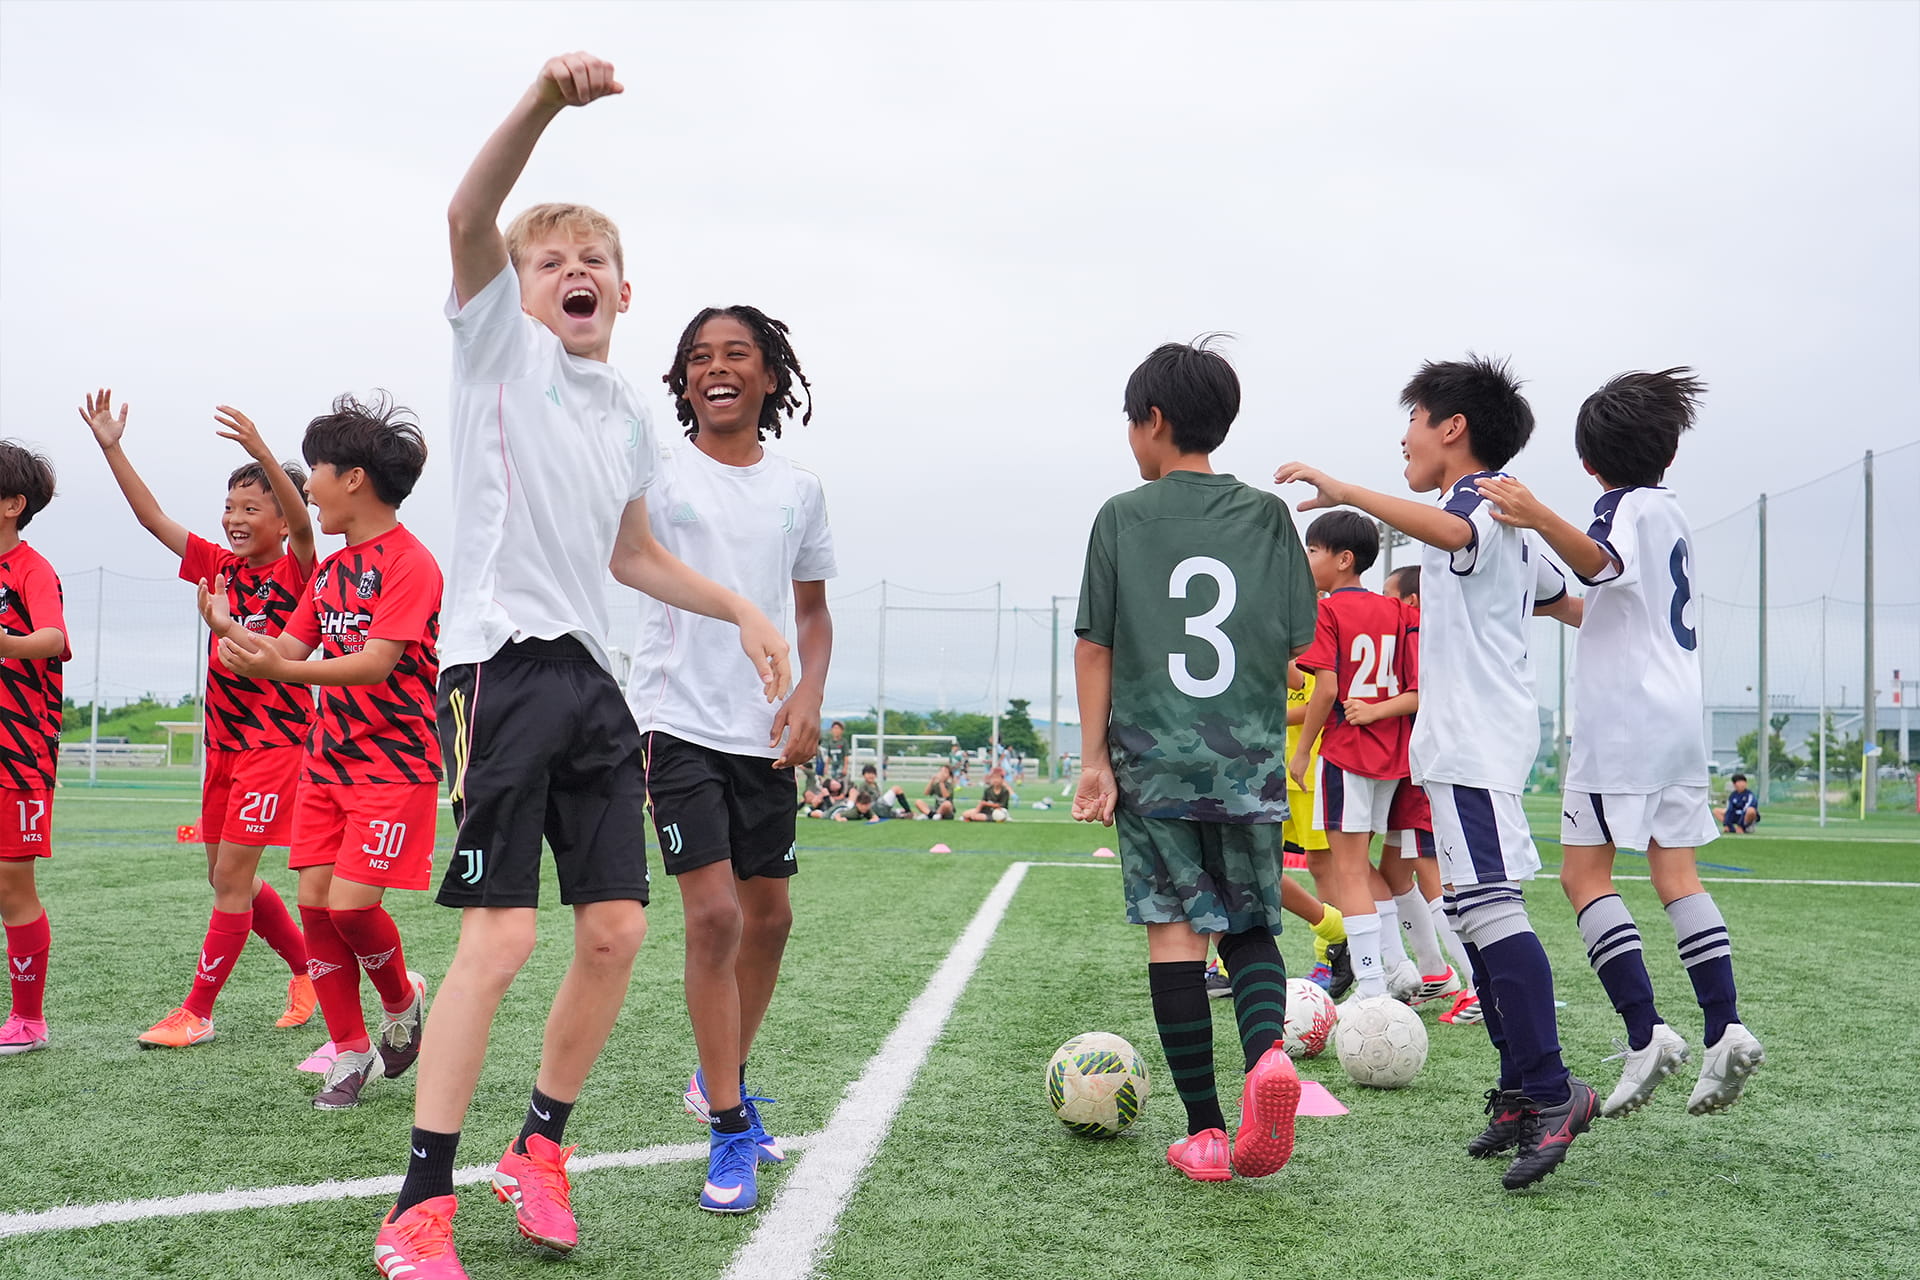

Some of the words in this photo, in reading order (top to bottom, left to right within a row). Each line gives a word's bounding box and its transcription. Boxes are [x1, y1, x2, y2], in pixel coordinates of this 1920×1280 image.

[1167, 555, 1238, 699] 3
[1347, 633, 1400, 698] 24
[16, 799, 45, 832] 17
[239, 791, 279, 823] 20
[22, 833, 43, 842] NZS
[245, 824, 265, 833] NZS
[361, 819, 407, 858] 30
[368, 858, 390, 870] NZS
